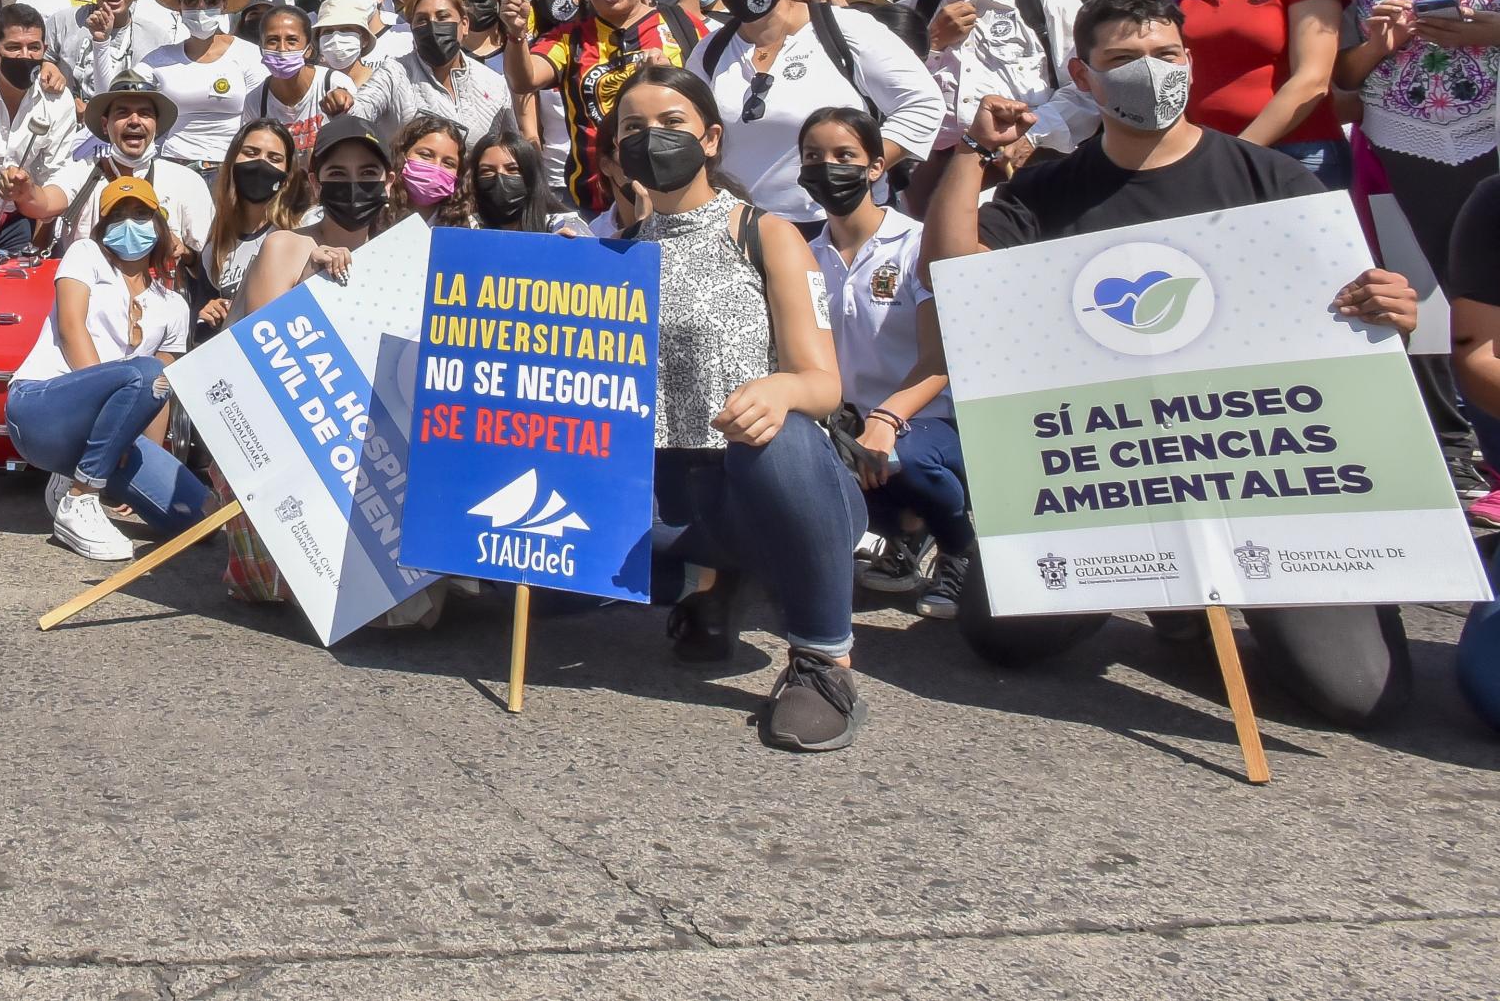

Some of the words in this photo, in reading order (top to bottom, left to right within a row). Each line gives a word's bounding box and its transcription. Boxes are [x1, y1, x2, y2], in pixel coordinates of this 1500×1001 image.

[434, 272, 467, 306] LA
[477, 276, 648, 323] AUTONOMÍA
[286, 316, 326, 350] SÍ
[429, 315, 647, 366] UNIVERSITARIA
[252, 320, 307, 401] CIVIL
[299, 397, 340, 446] DE
[305, 351, 345, 396] AL
[425, 357, 464, 392] NO
[474, 361, 507, 397] SE
[518, 365, 649, 418] NEGOCIA,
[231, 402, 264, 452] UNIVERSIDAD
[421, 404, 465, 442] ¡SE
[475, 408, 611, 458] RESPETA!
[1034, 403, 1075, 438] SÍ
[1085, 401, 1142, 435] AL
[1152, 385, 1323, 429] MUSEO
[224, 406, 263, 469] GUADALAJARA
[335, 394, 411, 489] HOSPI
[1041, 446, 1099, 476] DE
[1109, 425, 1337, 468] CIENCIAS
[1033, 464, 1373, 516] AMBIENTALES
[291, 526, 323, 577] GUADALAJARA
[477, 532, 574, 576] STAUdeG
[1074, 553, 1155, 566] UNIVERSIDAD
[1159, 552, 1175, 560] DE
[1075, 563, 1178, 577] GUADALAJARA
[1278, 550, 1341, 563] HOSPITAL
[1346, 547, 1383, 561] CIVIL
[1387, 548, 1405, 558] DE
[1281, 561, 1374, 573] GUADALAJARA
